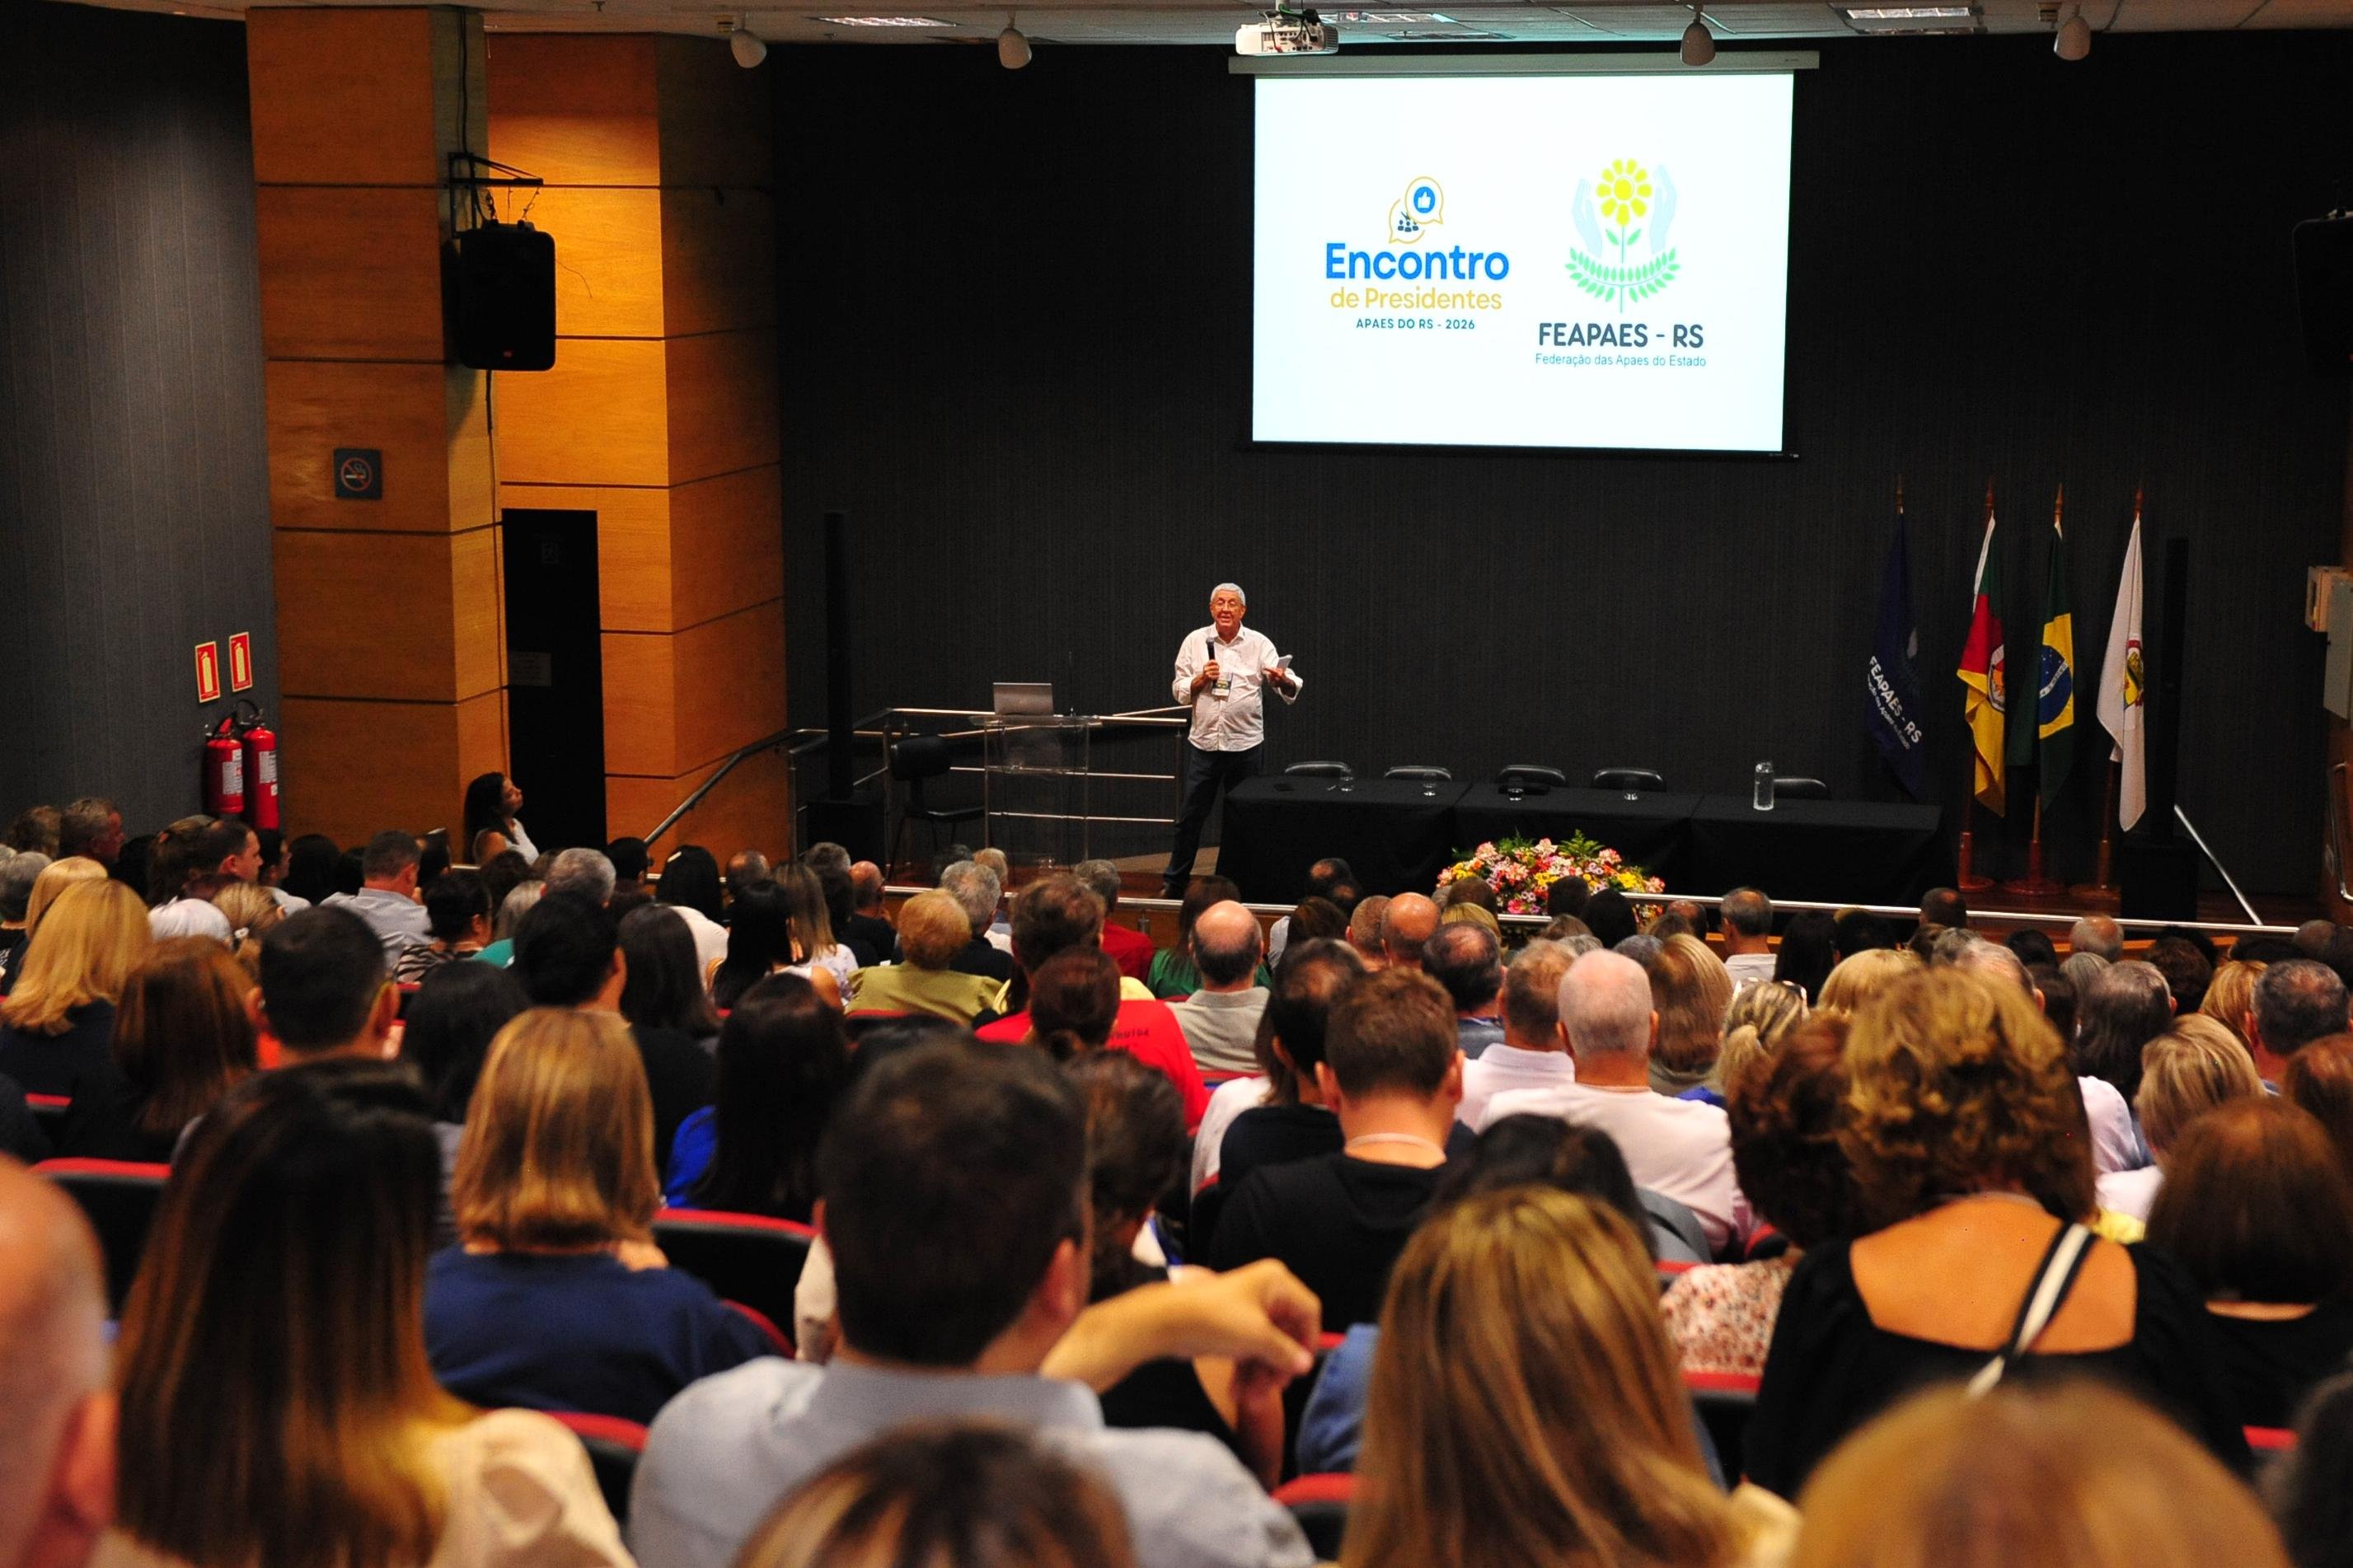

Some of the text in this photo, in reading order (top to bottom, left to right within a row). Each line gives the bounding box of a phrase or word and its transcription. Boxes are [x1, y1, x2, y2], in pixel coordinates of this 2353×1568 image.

[1325, 243, 1510, 281] Encontro
[1330, 286, 1502, 311] de Presidentes
[1356, 318, 1394, 329] APAES
[1398, 318, 1415, 329] DO
[1418, 319, 1434, 330] RS
[1446, 319, 1475, 330] 2026
[1539, 323, 1648, 348] FEAPAES
[1673, 324, 1704, 349] RS
[1535, 353, 1707, 368] Federação das Apaes do Estado
[1869, 655, 1903, 716] FEAPAES
[1904, 721, 1922, 743] RS
